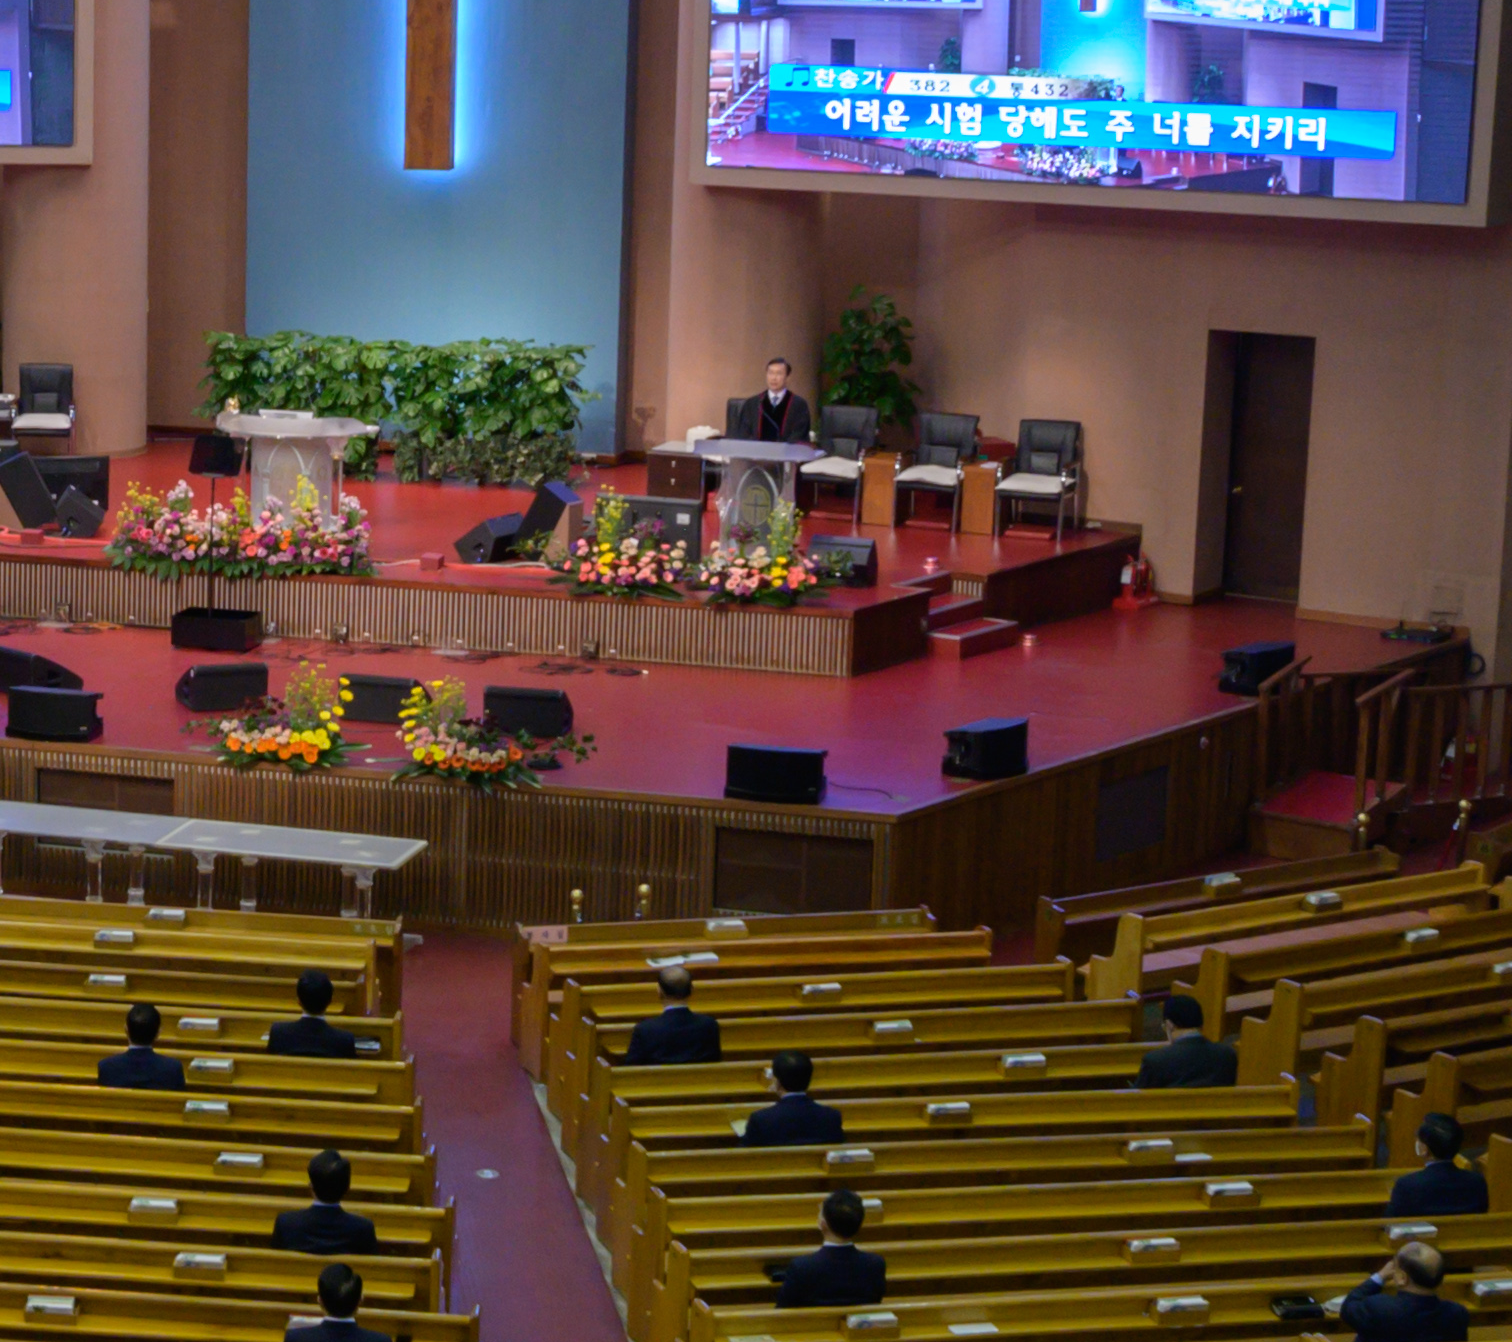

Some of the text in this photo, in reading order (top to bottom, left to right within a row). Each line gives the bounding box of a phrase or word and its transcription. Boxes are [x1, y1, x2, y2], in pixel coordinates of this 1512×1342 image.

[813, 68, 884, 90] 찬송가
[909, 79, 950, 93] 382
[974, 77, 991, 95] 4
[824, 97, 910, 132] 어려운
[925, 102, 982, 136] 시험
[998, 104, 1089, 139] 당해도
[1105, 110, 1135, 143] 주
[1231, 114, 1326, 151] 지키리
